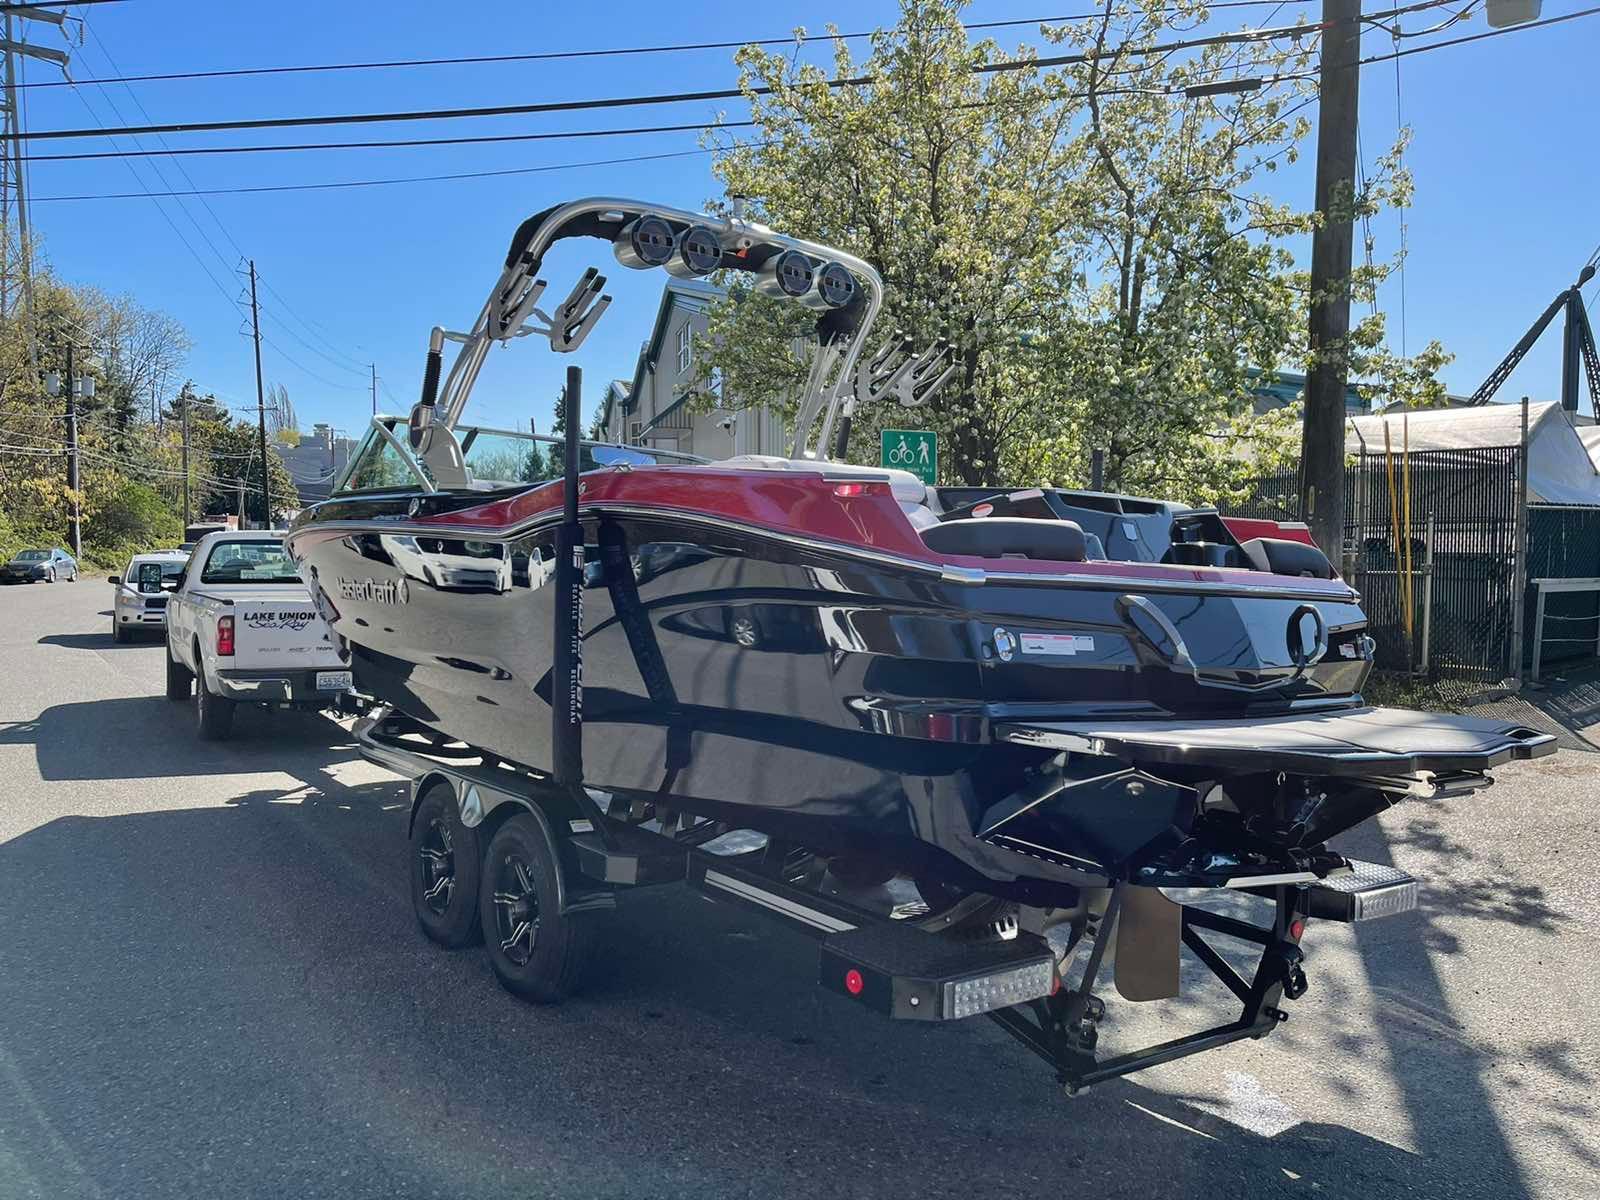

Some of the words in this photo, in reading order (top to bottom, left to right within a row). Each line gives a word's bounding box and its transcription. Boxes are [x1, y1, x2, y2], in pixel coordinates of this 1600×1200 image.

[243, 612, 275, 621] LAKE
[278, 611, 316, 621] UNION
[248, 620, 278, 630] Sea
[279, 619, 310, 631] Ray
